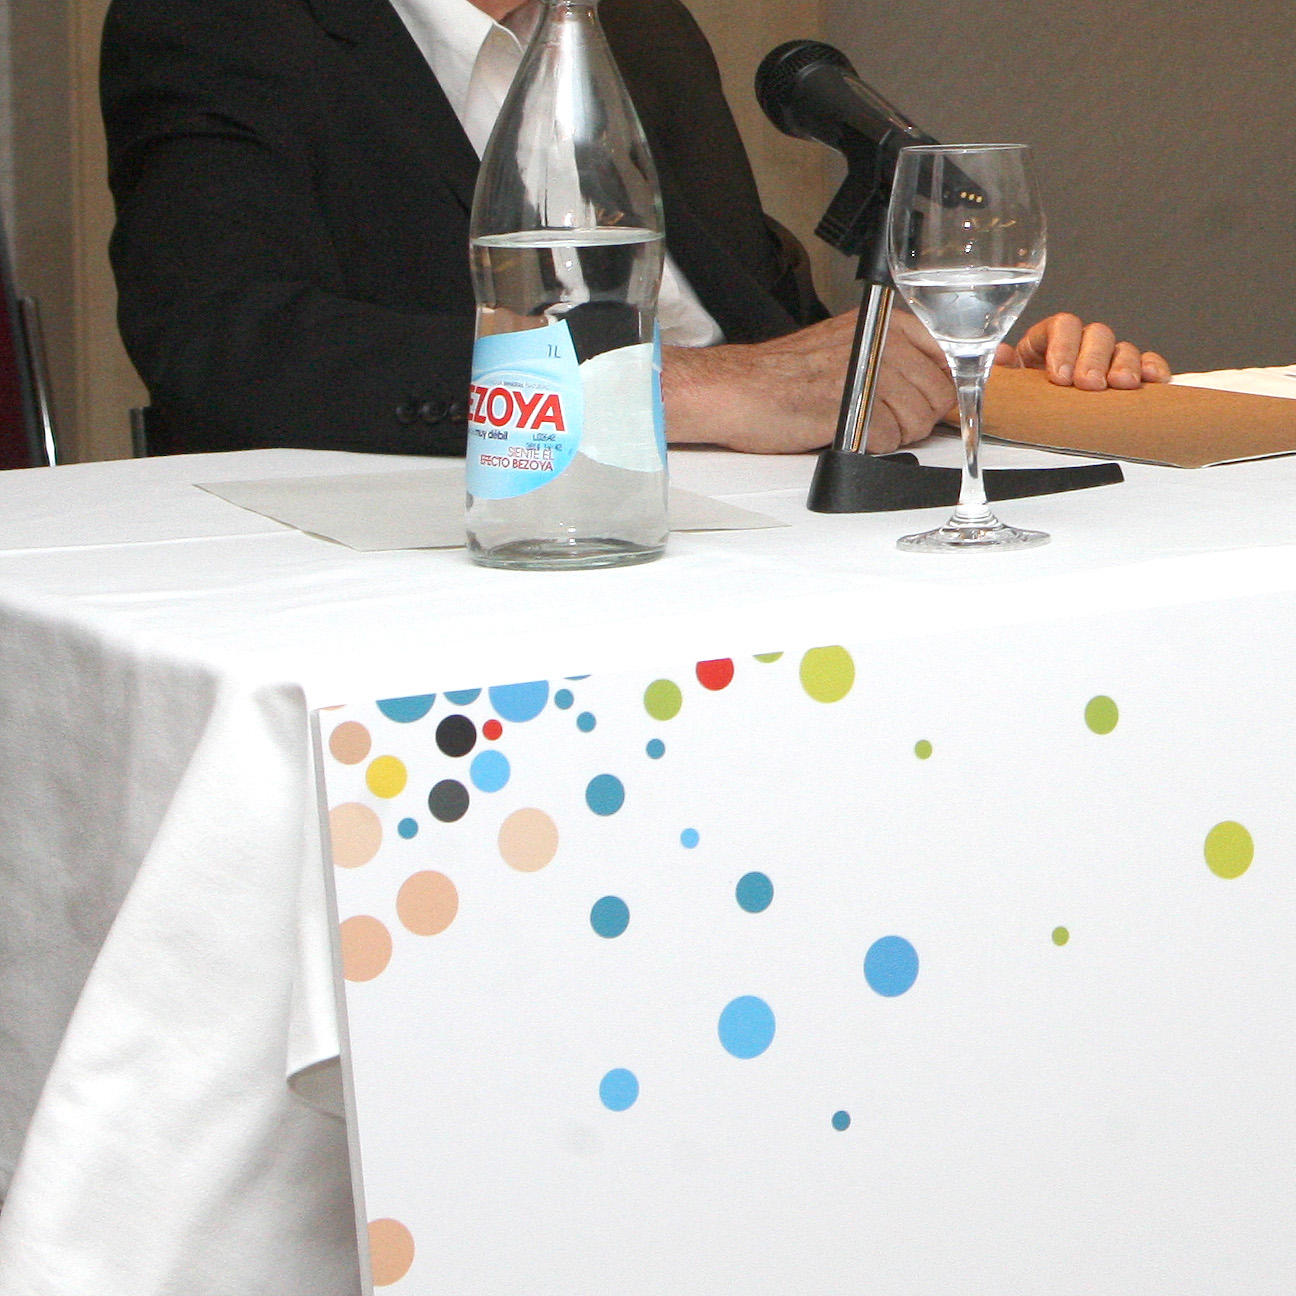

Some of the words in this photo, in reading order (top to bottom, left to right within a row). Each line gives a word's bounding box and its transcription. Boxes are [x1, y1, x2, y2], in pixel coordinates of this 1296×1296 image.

[468, 384, 566, 433] EZOYA
[480, 454, 511, 468] EFECTO
[512, 458, 554, 472] BEZOYA
